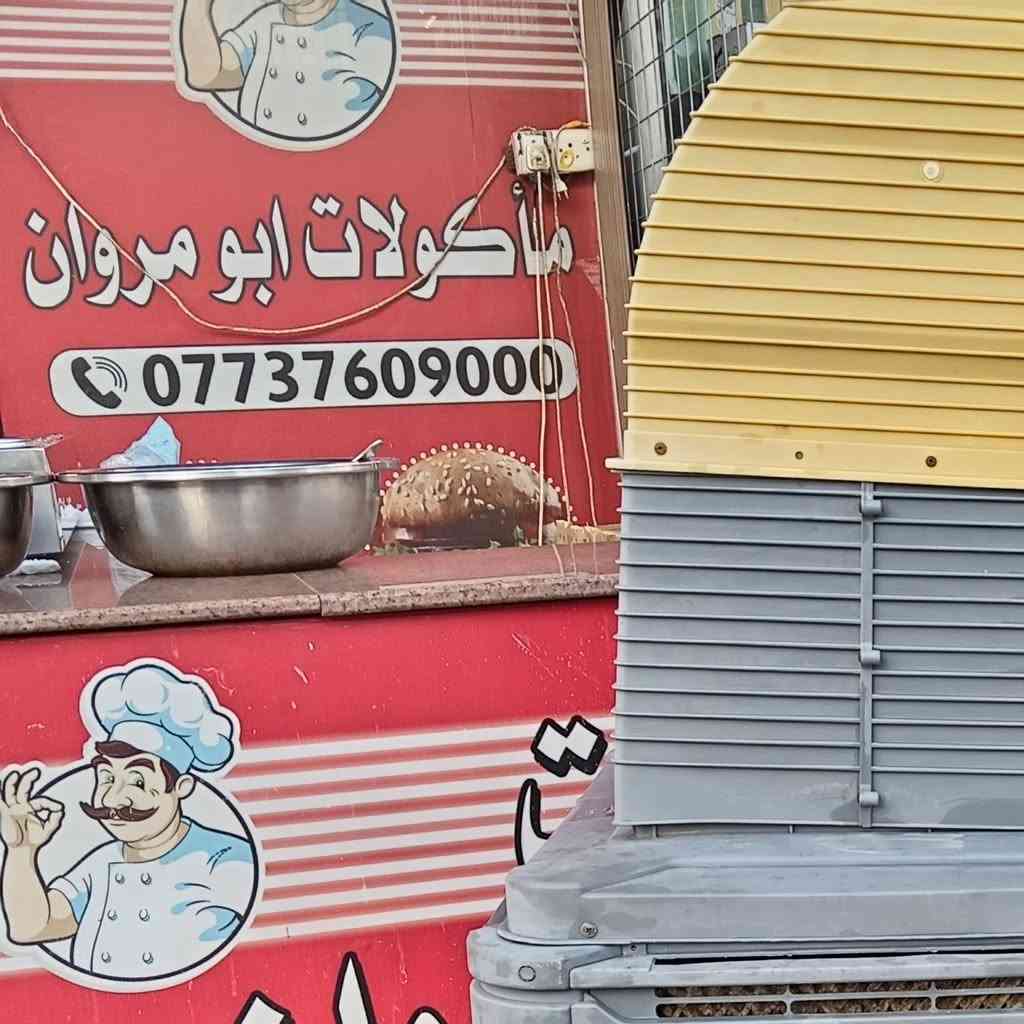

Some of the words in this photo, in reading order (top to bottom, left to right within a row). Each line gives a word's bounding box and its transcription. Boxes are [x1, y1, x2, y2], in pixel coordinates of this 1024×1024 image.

[22, 200, 200, 310] مروان
[210, 195, 291, 307] ابو
[141, 342, 565, 408] 07737609000
